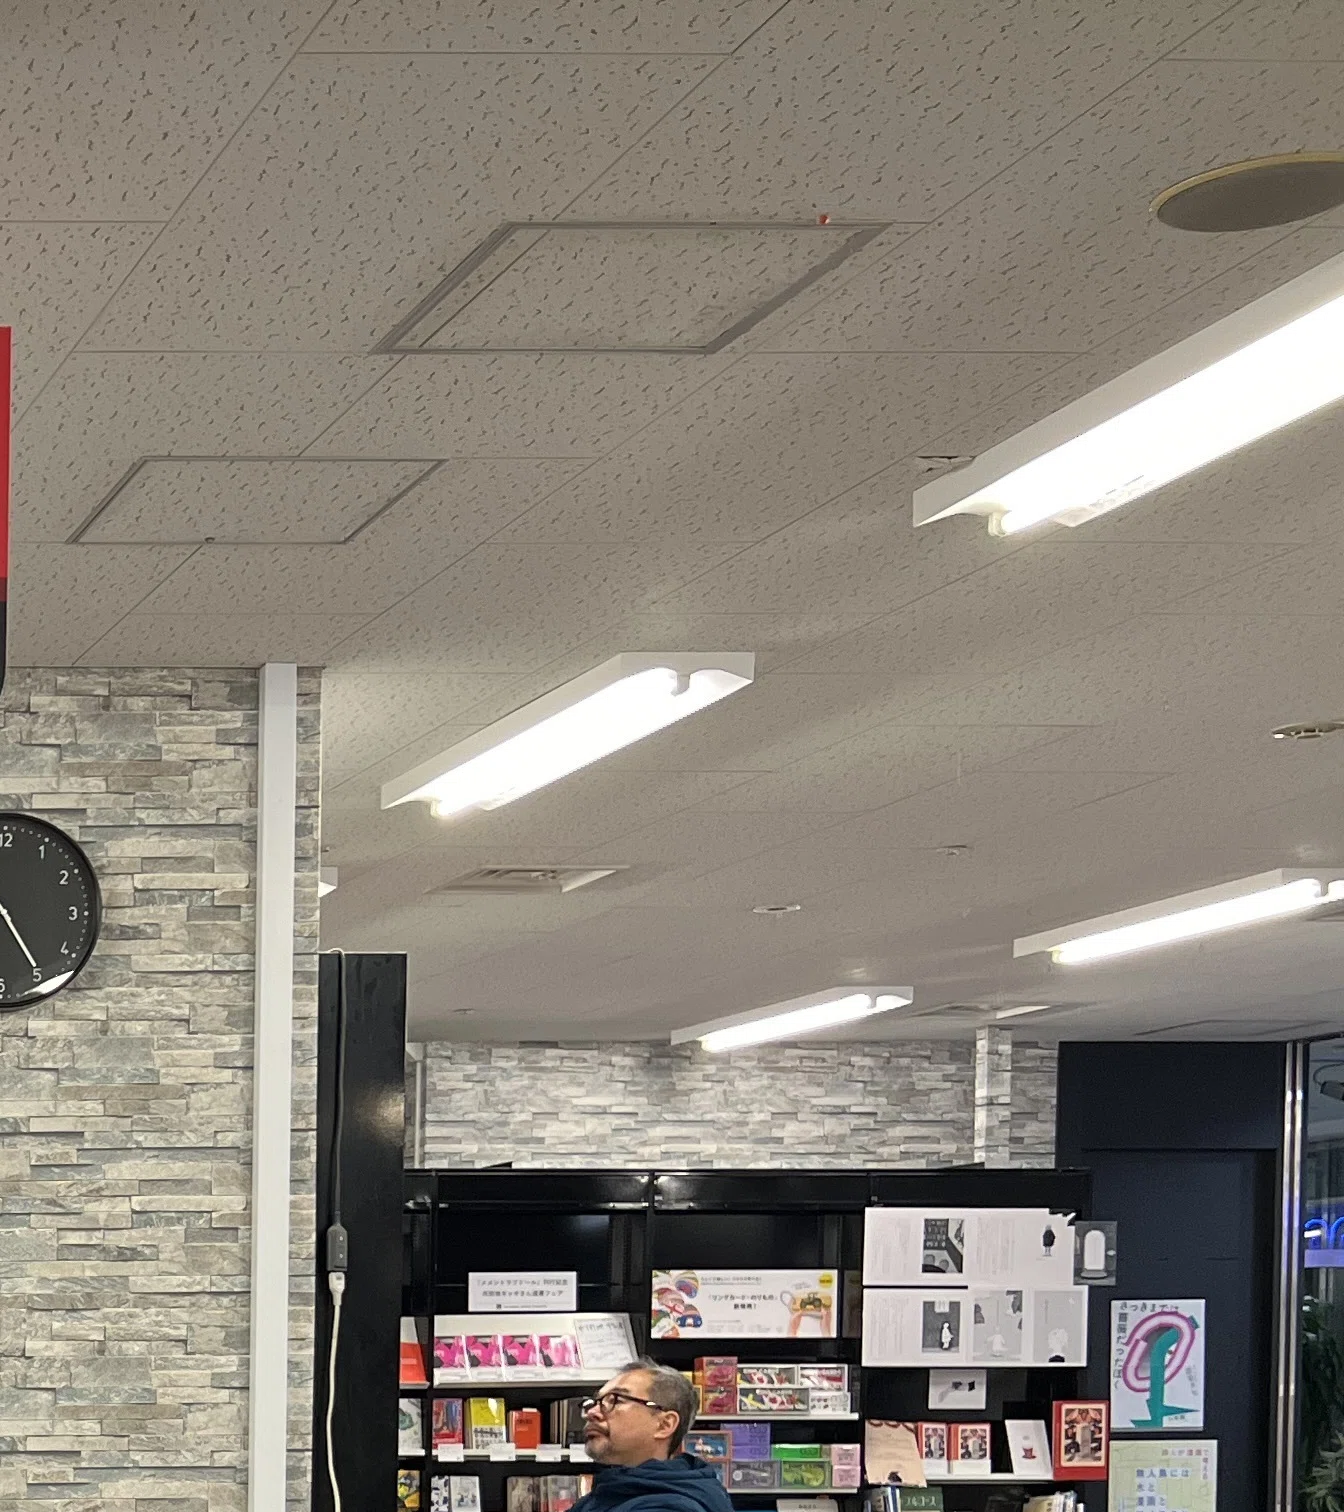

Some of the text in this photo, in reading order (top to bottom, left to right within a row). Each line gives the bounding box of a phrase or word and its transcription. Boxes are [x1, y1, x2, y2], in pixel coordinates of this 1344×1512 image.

[39, 845, 45, 859] 1
[59, 870, 69, 885] 2
[69, 906, 78, 921] 3
[60, 941, 68, 955] 4
[32, 968, 42, 982] 5
[1119, 1302, 1179, 1313] さっきまでは
[1136, 1468, 1189, 1479] 無人島には
